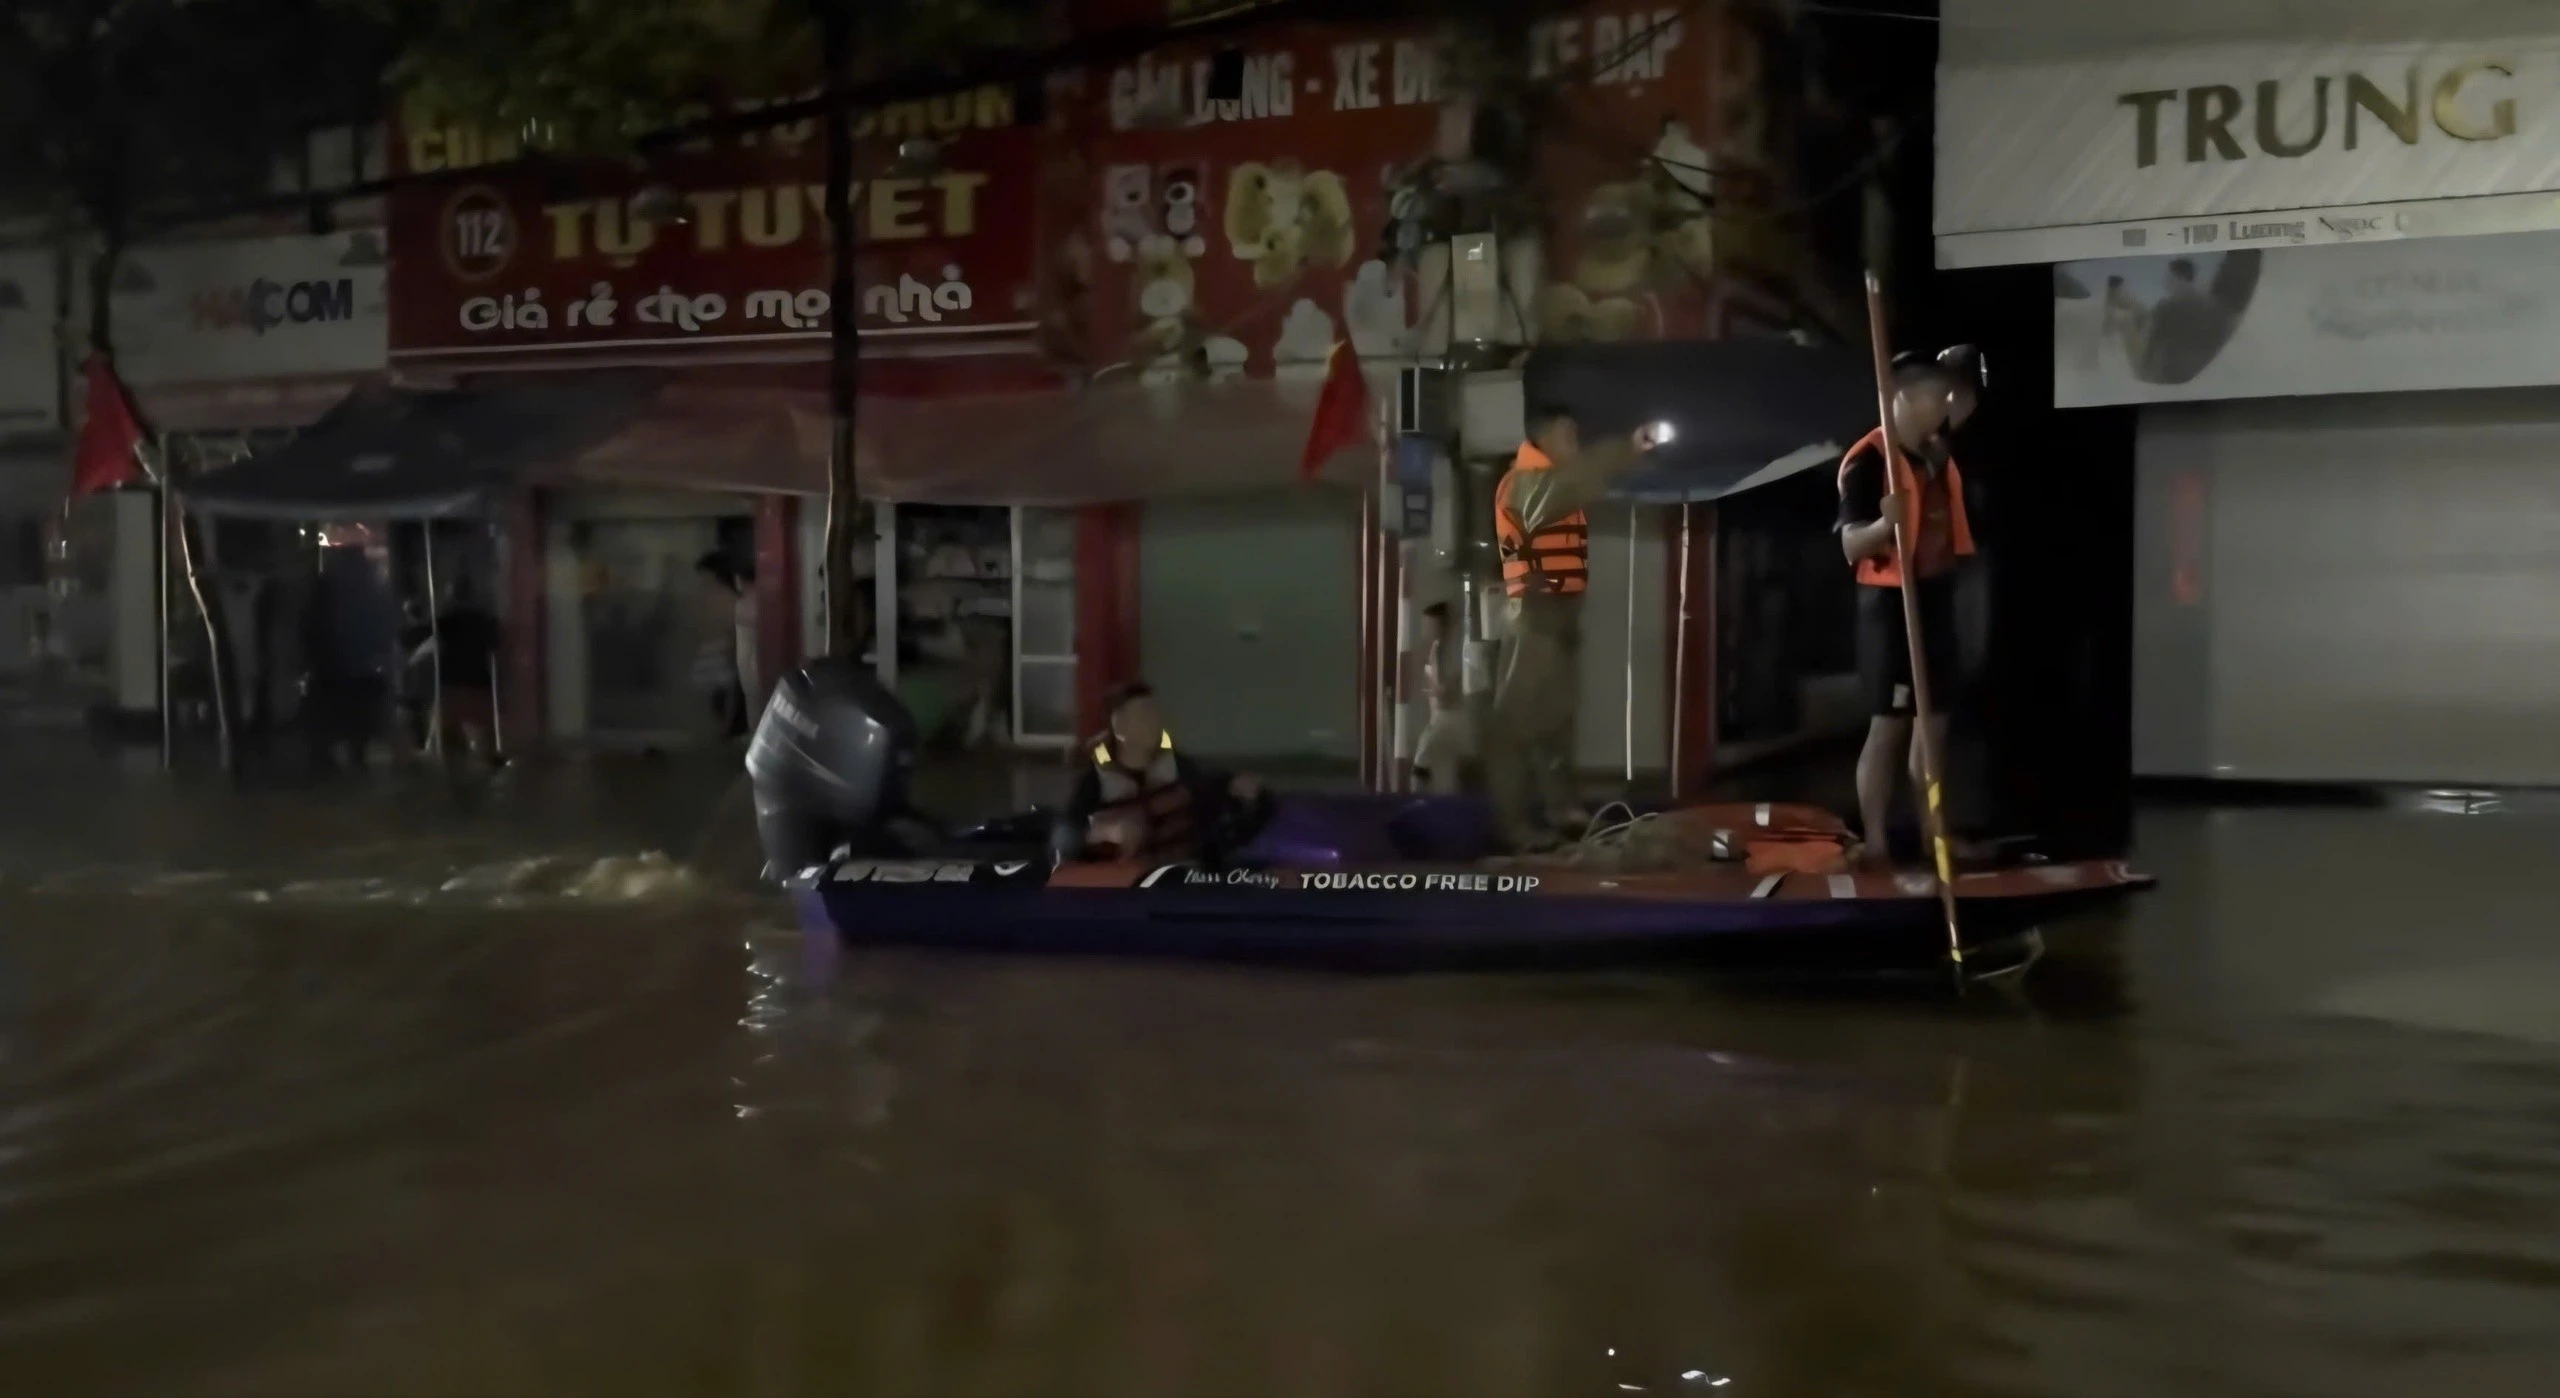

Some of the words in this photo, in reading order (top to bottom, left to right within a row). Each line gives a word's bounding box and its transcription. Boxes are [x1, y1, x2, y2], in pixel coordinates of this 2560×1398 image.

[1332, 42, 1381, 111] XE
[2117, 63, 2517, 169] TRUNG
[457, 209, 506, 258] 112
[635, 284, 727, 331] cho
[1301, 873, 1417, 890] TOBACCO
[1425, 874, 1489, 892] FREE
[1497, 876, 1540, 892] DIP
